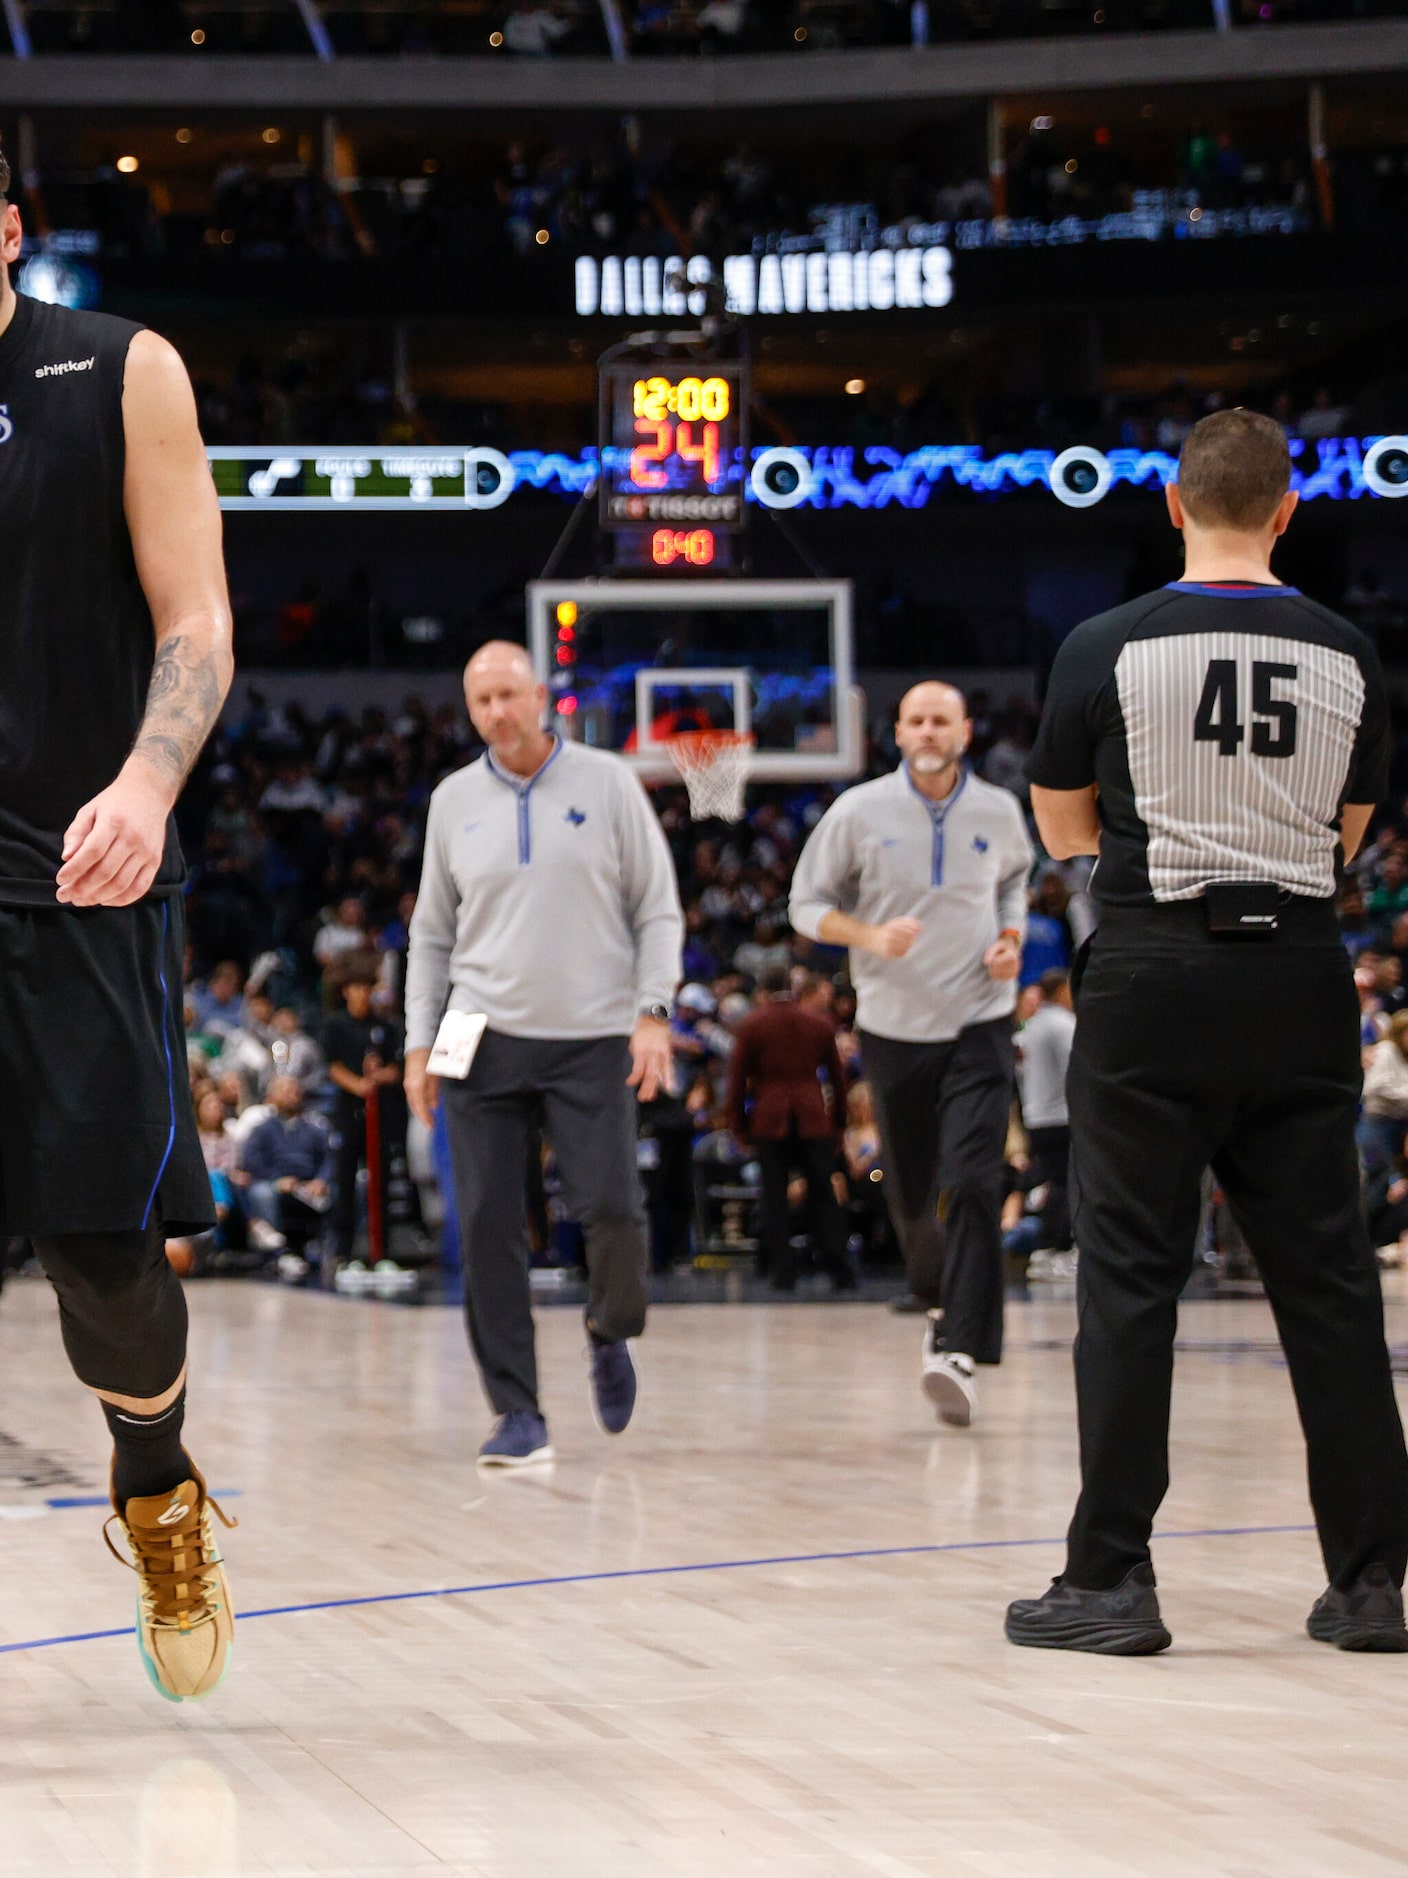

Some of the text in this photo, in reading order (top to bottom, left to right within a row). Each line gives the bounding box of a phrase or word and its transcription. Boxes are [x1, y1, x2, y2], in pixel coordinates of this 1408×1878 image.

[724, 246, 952, 315] MAVERICKS
[35, 357, 95, 379] shiftkey
[634, 377, 729, 421] 12:00
[630, 417, 719, 488] 24
[1194, 659, 1297, 758] 45
